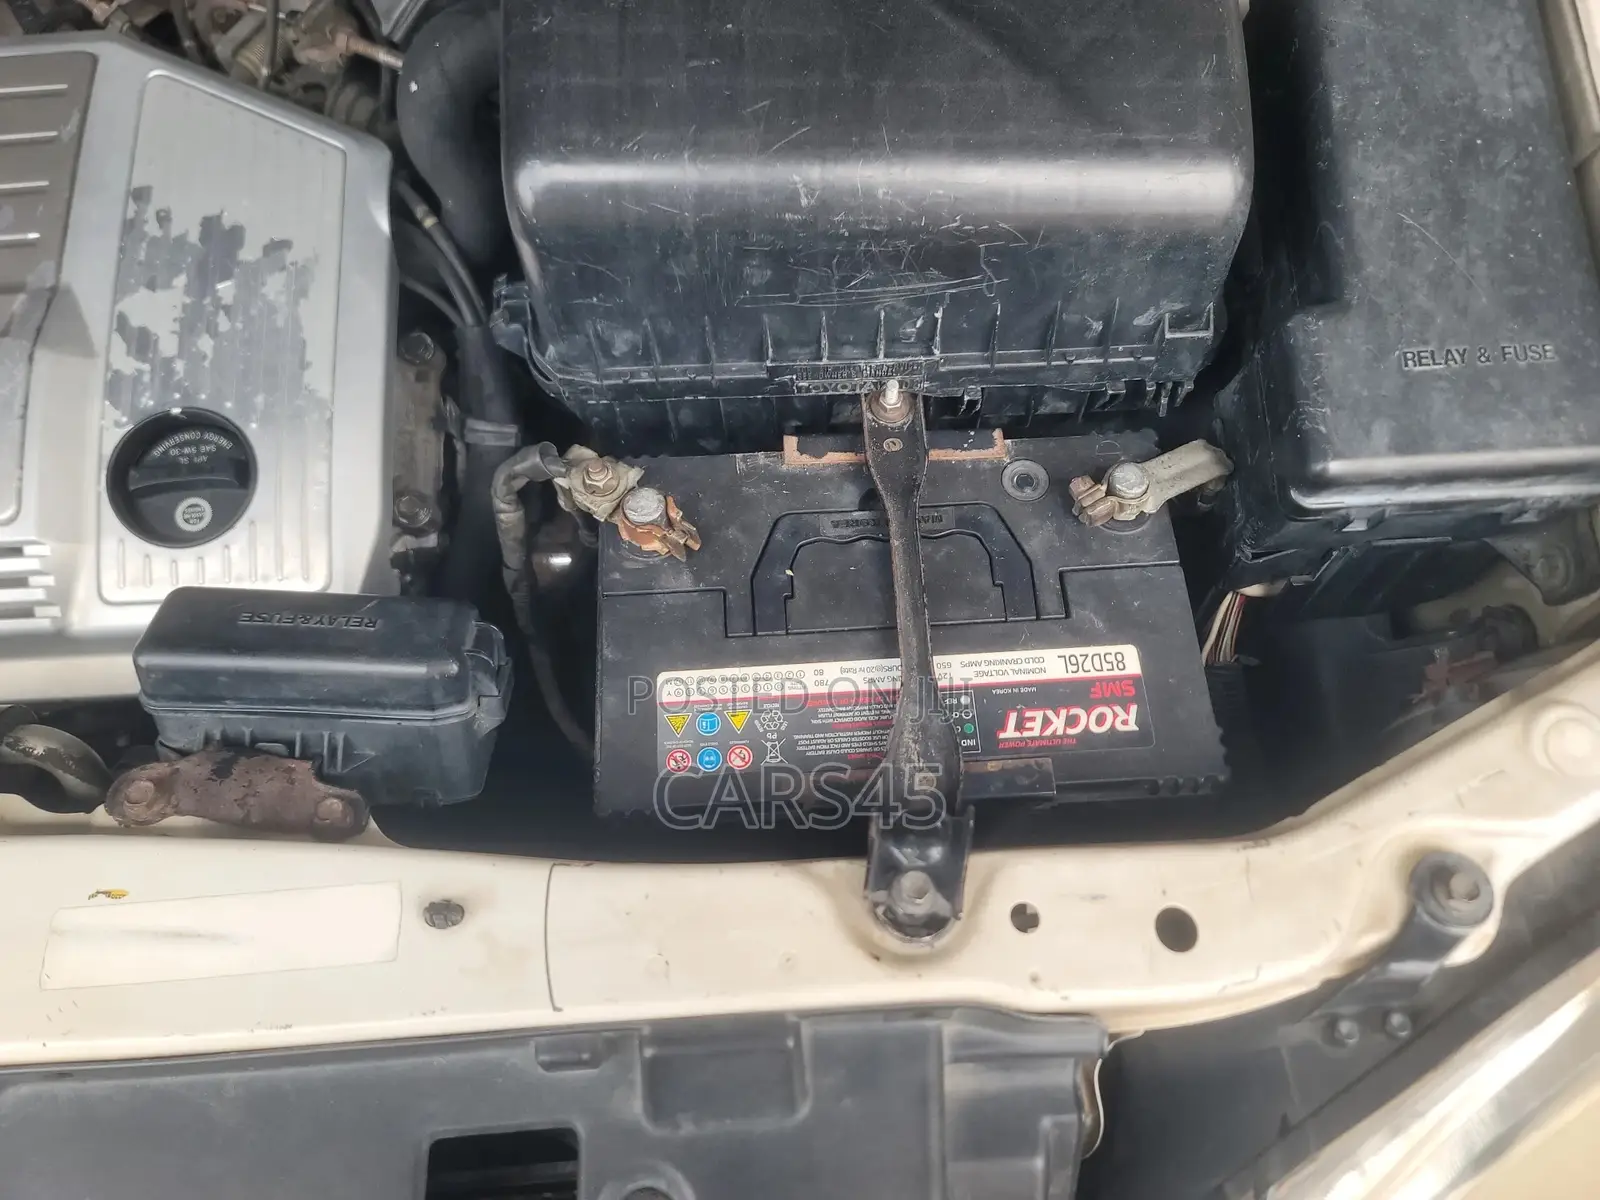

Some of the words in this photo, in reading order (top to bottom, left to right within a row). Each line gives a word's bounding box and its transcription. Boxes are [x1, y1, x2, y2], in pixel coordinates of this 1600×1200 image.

[1402, 348, 1468, 368] RELAY
[1477, 346, 1492, 364] &
[1500, 344, 1556, 363] FUSE
[152, 430, 201, 457] CONSERVING
[204, 430, 234, 450] ENERGY
[169, 446, 197, 456] 5W-30
[200, 444, 216, 453] SAE
[193, 454, 208, 463] API
[936, 661, 952, 669] 650
[960, 660, 983, 668] AMPS
[983, 657, 1023, 667] CRANKING
[1024, 656, 1045, 665] COLD
[1057, 651, 1126, 674] 85D26L
[973, 668, 1009, 678] VOLTAGE
[1010, 666, 1047, 675] NOMINAL
[813, 679, 830, 687] 780
[1089, 679, 1136, 699] SMF
[996, 703, 1139, 739] ROCKET
[998, 740, 1026, 749] POWER
[1025, 738, 1061, 748] ULTIMATE
